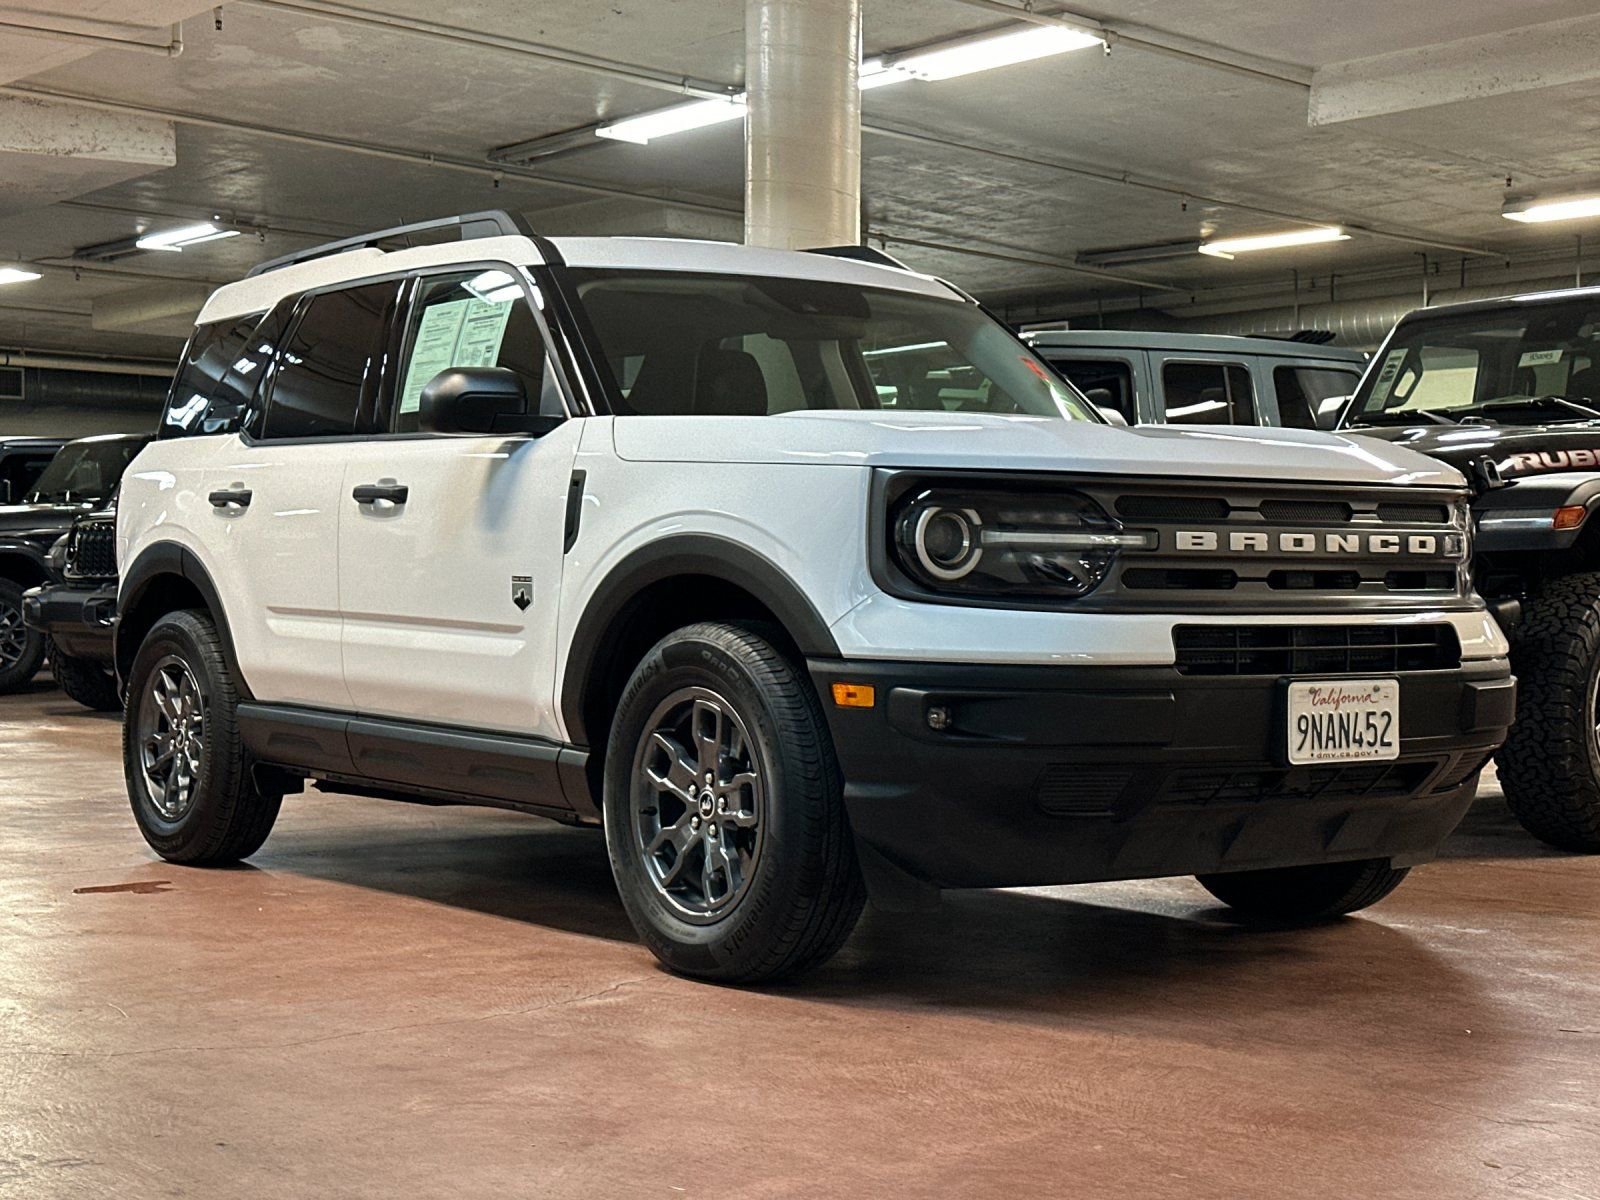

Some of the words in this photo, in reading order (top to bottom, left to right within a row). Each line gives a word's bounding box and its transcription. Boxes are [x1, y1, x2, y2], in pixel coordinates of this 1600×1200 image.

[1176, 531, 1436, 553] BRONCO
[1312, 687, 1379, 710] California
[1297, 711, 1393, 751] 9NAN452
[1316, 751, 1372, 759] dmv.ca.gov
